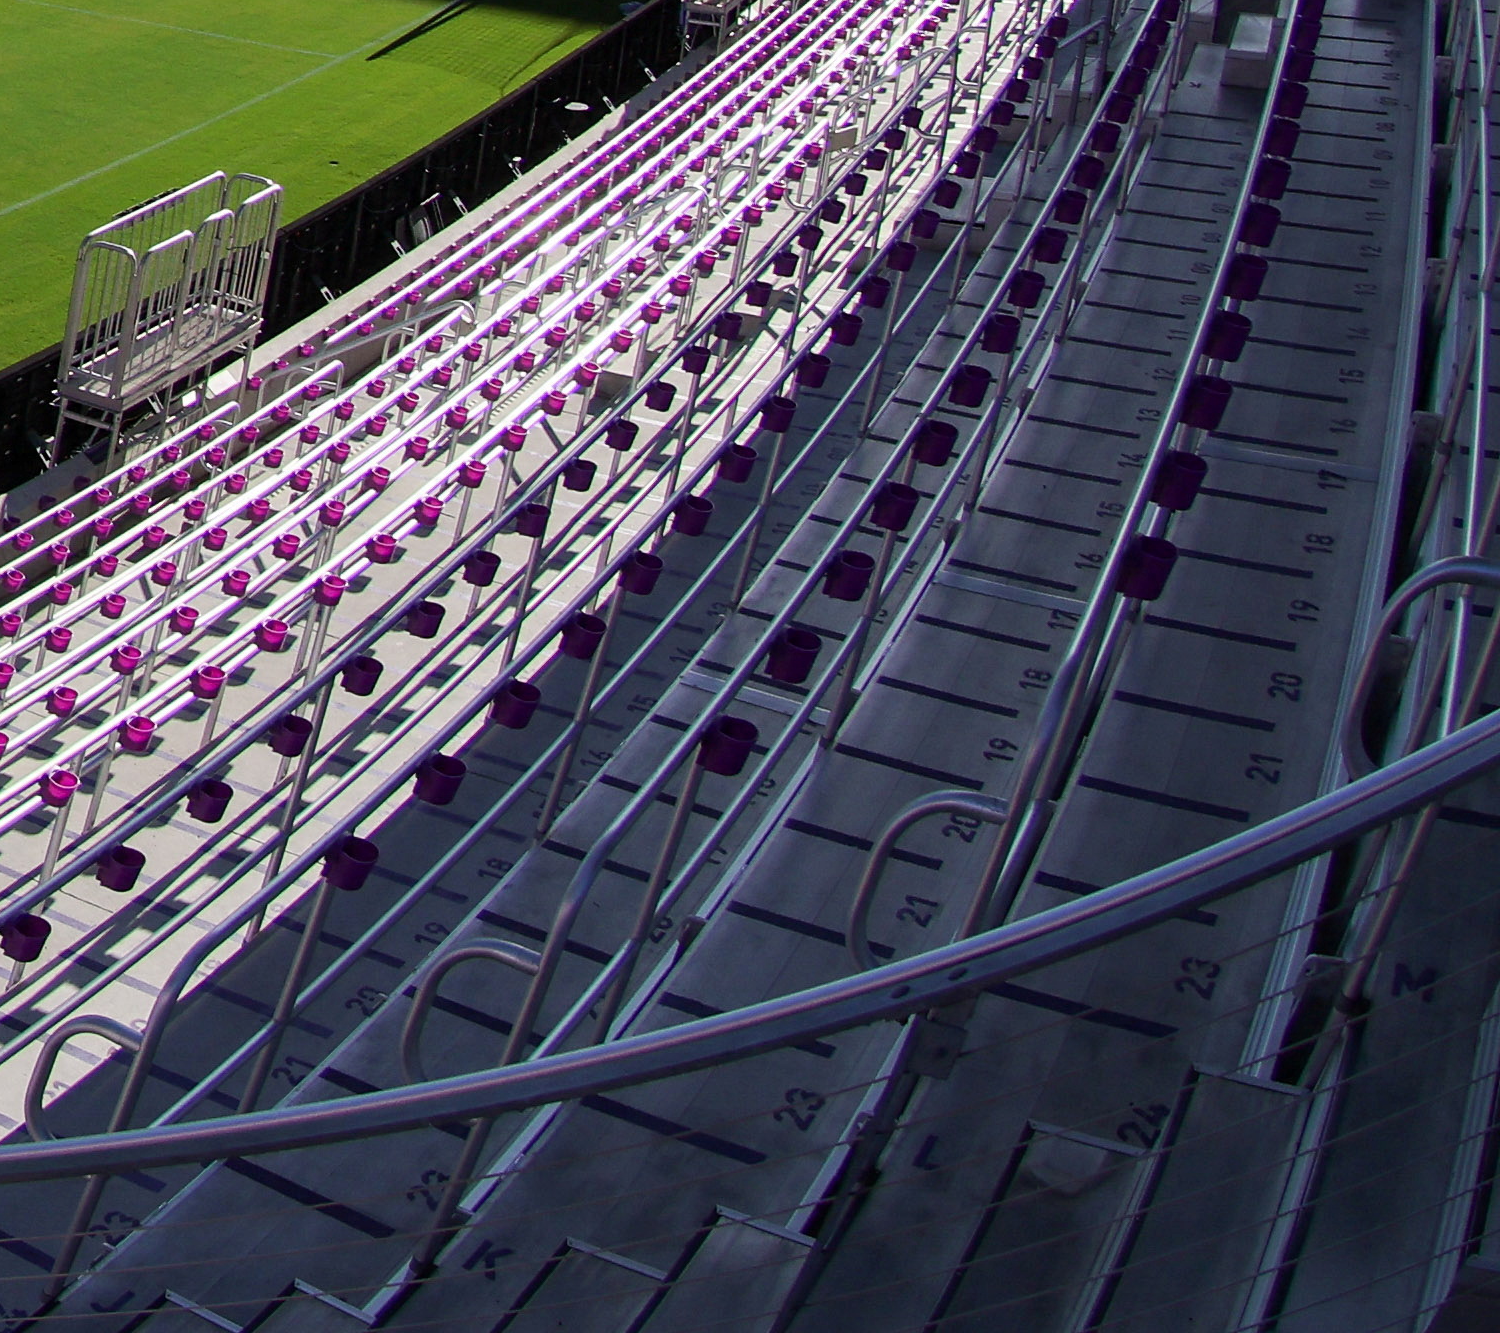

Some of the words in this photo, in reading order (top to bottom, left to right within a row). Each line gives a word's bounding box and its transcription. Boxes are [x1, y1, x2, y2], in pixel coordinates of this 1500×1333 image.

[1338, 367, 1366, 385] 15
[1136, 407, 1161, 423] 13
[1328, 417, 1357, 434] 16
[1118, 450, 1147, 469] 14
[1317, 468, 1348, 490] 17
[1303, 533, 1335, 555] 18
[1074, 548, 1104, 572] 16
[1047, 607, 1079, 632] 17
[1287, 599, 1321, 623] 19
[1018, 668, 1053, 691] 18
[1268, 671, 1304, 702] 20
[983, 737, 1019, 763] 19
[1245, 752, 1284, 785] 21
[942, 810, 983, 844] 20
[896, 893, 939, 928] 21
[414, 920, 449, 945] 19
[1174, 956, 1222, 1002] 23
[271, 1055, 317, 1087] 21
[773, 1086, 827, 1132] 23
[1116, 1099, 1171, 1150] 24
